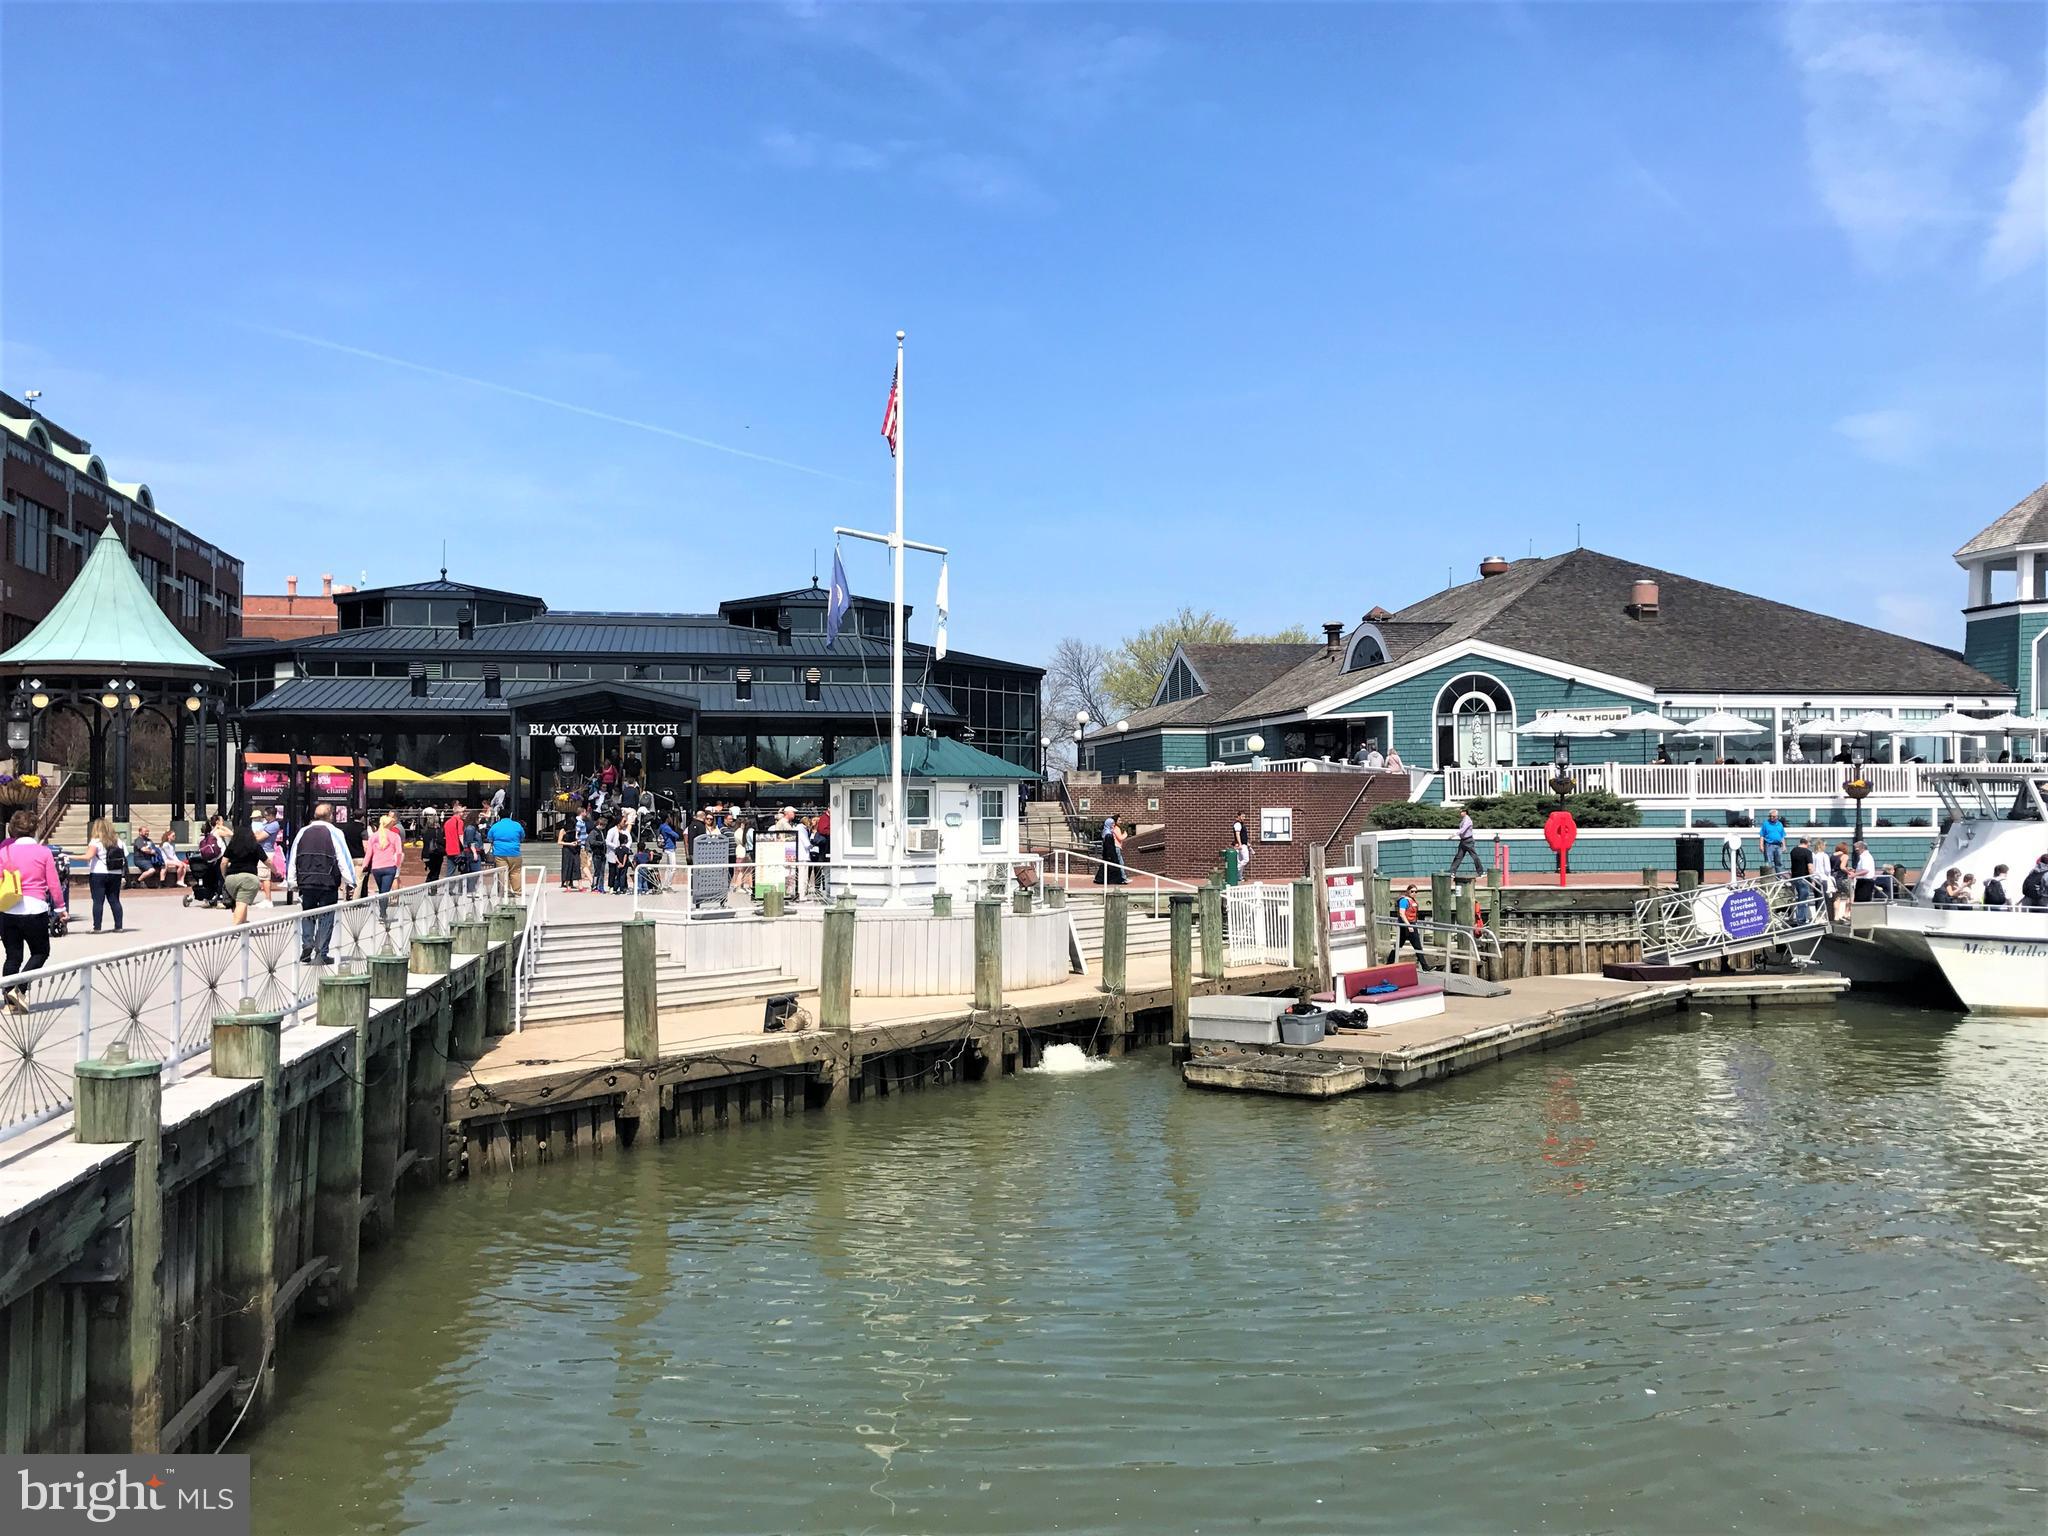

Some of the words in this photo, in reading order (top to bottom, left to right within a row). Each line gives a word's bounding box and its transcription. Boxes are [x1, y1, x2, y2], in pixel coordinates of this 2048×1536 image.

[528, 723, 621, 736] BLACKWALL
[626, 723, 679, 736] HITCH
[260, 786, 284, 794] history
[1731, 896, 1754, 905] Potomac
[1730, 902, 1757, 912] Riverboat
[1731, 909, 1758, 918] Company
[1962, 943, 1996, 955] Miss
[2001, 944, 2048, 957] Mallo
